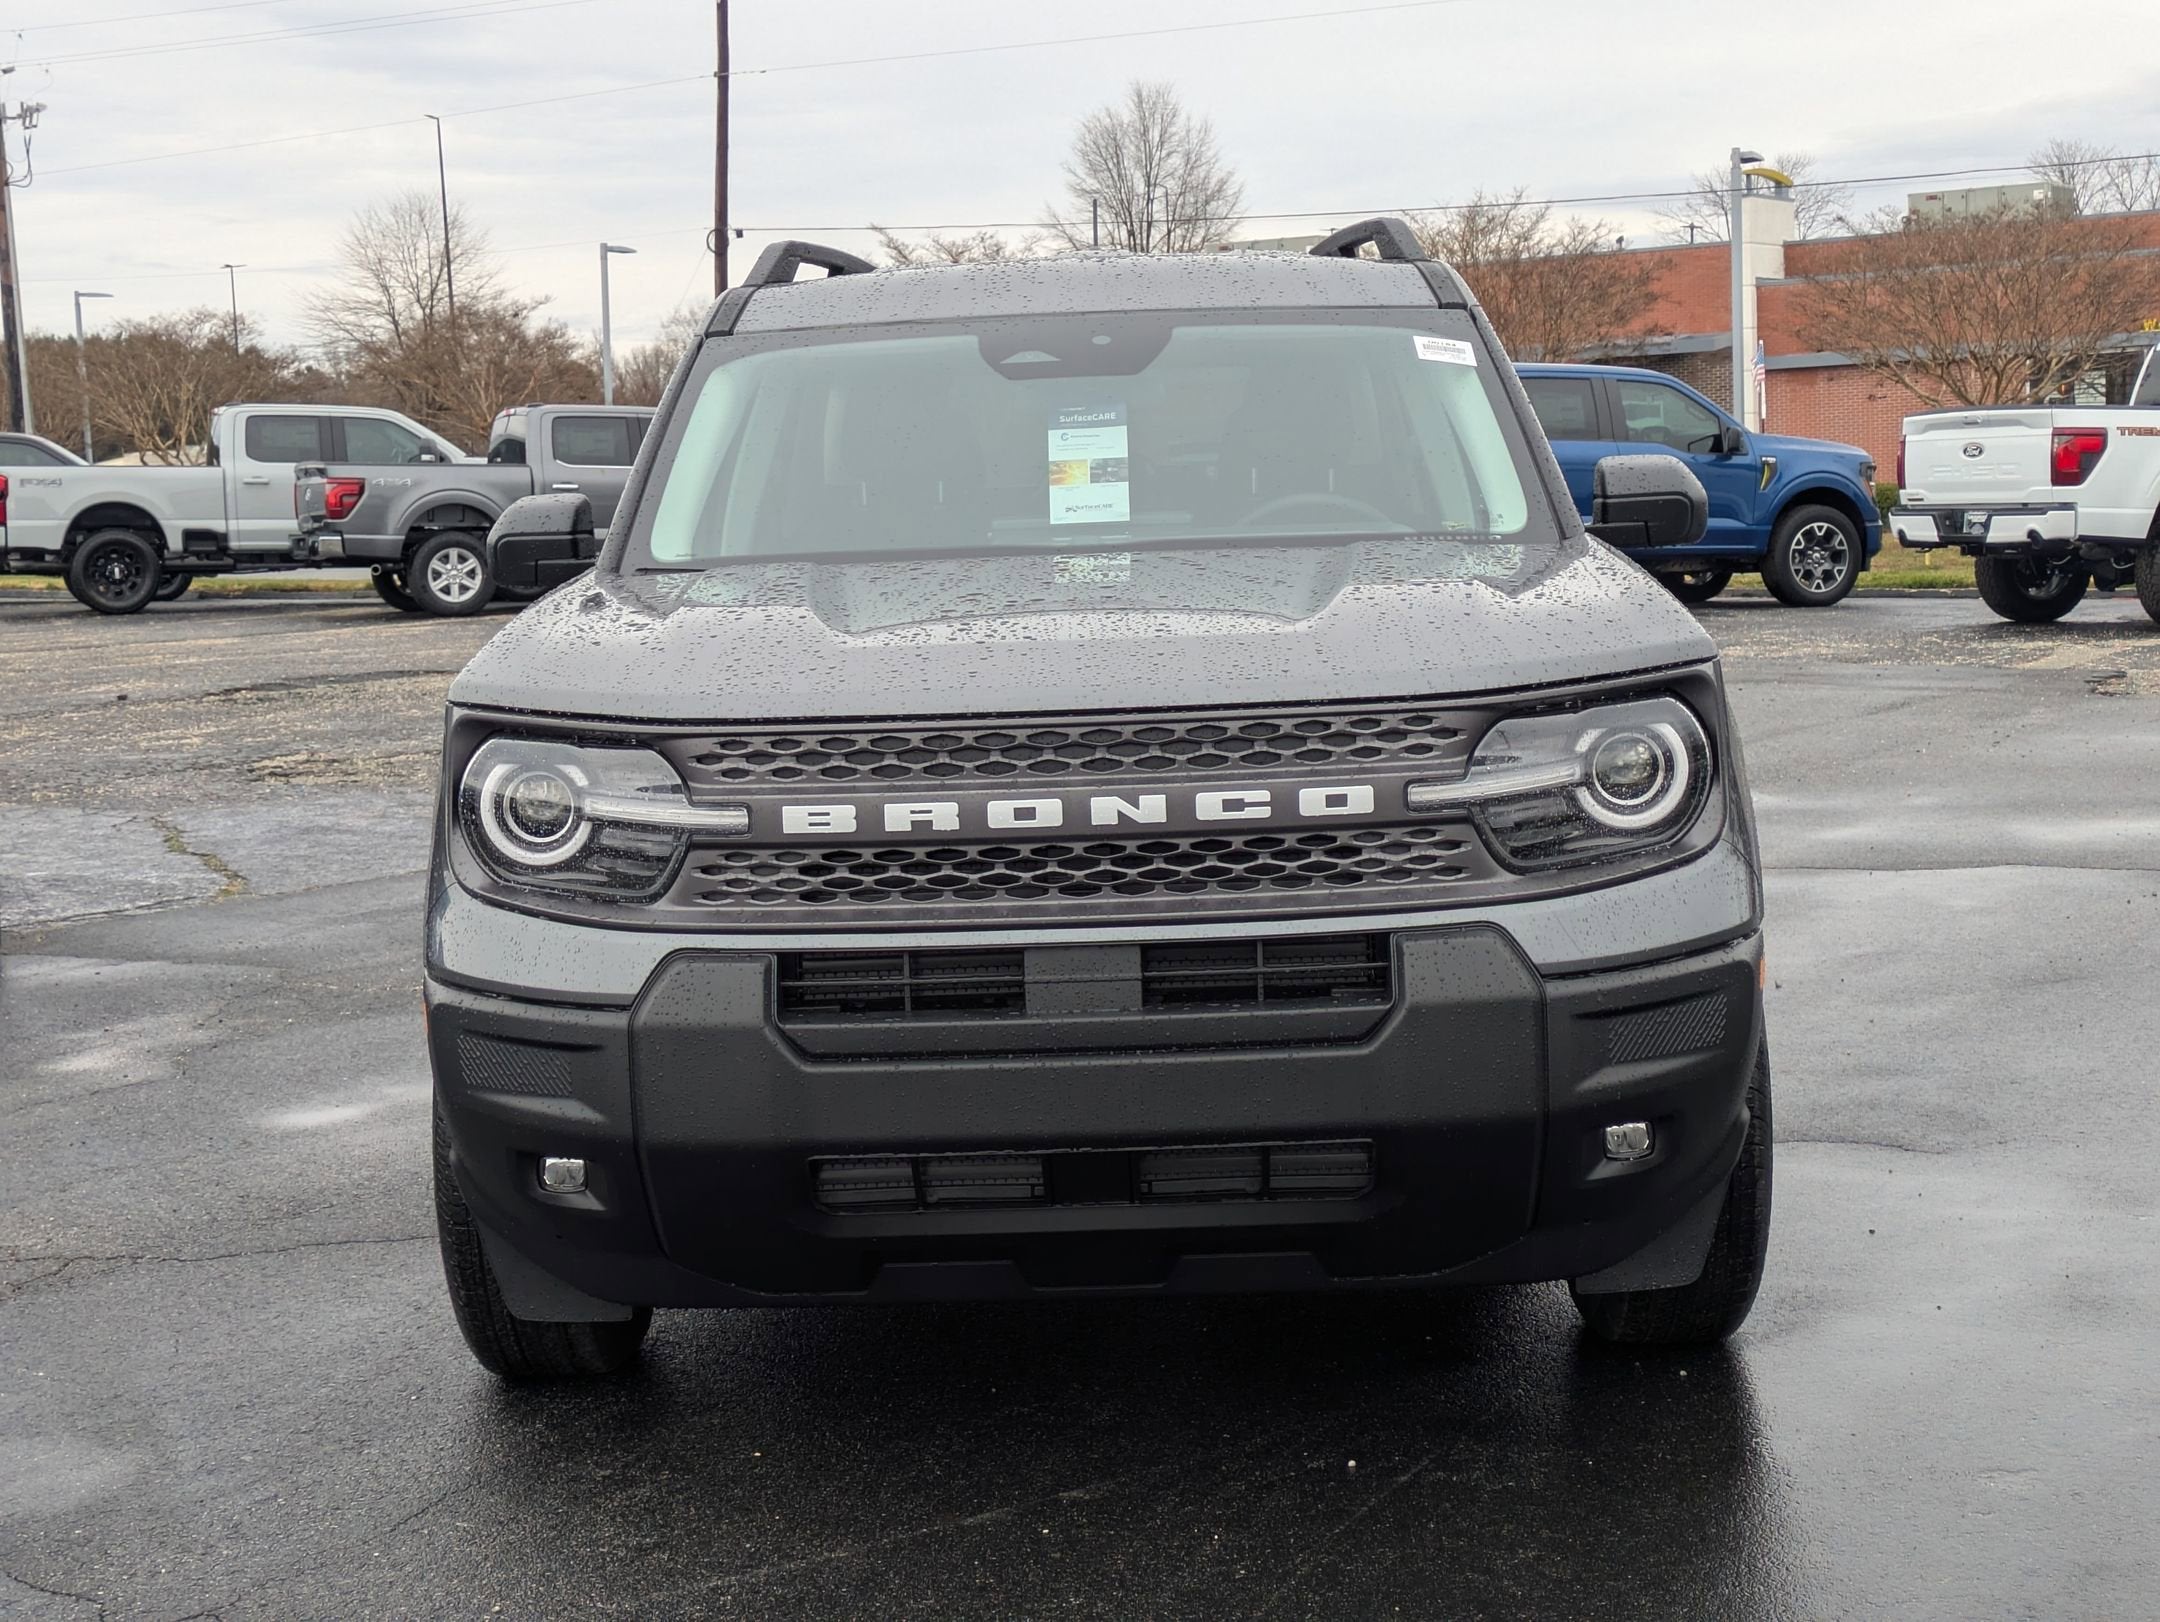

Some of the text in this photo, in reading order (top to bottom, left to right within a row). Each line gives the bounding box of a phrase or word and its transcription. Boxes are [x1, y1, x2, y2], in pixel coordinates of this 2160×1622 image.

[1059, 412, 1117, 423] SurfaceCARE
[20, 478, 62, 488] FX4
[782, 784, 1375, 834] BRONCO
